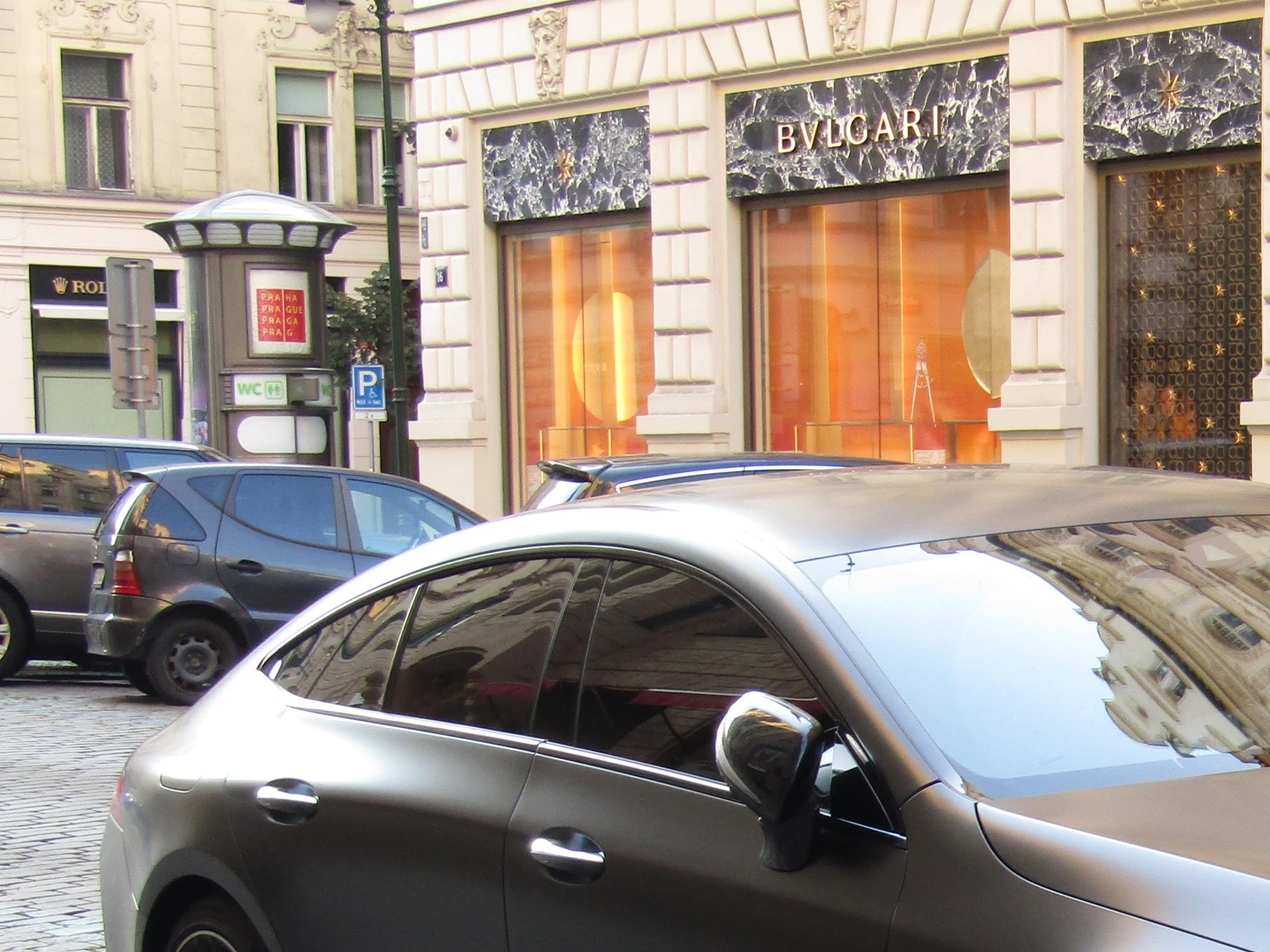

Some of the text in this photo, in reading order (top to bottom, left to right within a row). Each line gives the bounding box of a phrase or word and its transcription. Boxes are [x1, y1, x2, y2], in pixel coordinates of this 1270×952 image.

[777, 105, 942, 154] BVLGARI
[72, 280, 107, 295] ROL
[261, 293, 298, 302] PRA HA
[261, 304, 303, 314] PRA GUE
[262, 316, 299, 325] PRA GA
[262, 327, 293, 337] PRA G
[359, 370, 378, 396] P
[237, 383, 262, 396] WC
